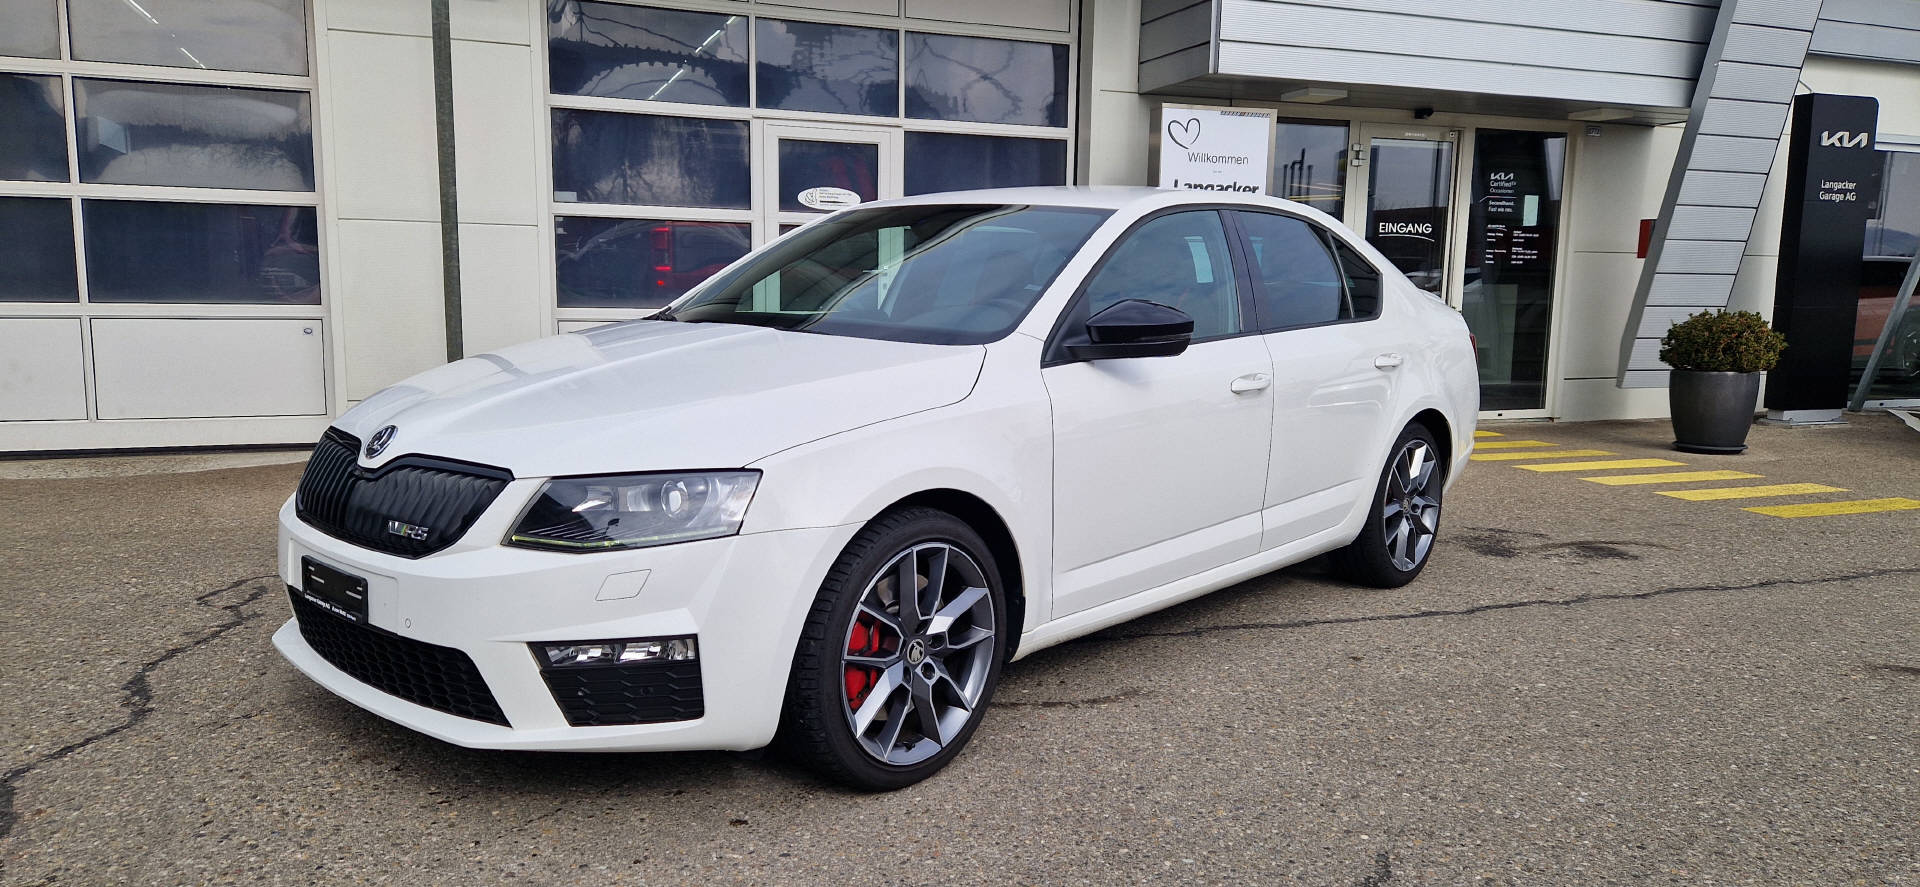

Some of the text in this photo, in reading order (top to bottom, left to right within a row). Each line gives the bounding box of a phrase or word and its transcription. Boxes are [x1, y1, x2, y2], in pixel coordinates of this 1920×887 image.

[1821, 131, 1869, 148] KIA
[1188, 152, 1249, 165] Willkommen
[1490, 172, 1514, 180] KIA
[1821, 180, 1856, 191] Langacker
[1819, 191, 1856, 203] Garage AG
[1379, 222, 1433, 234] EINGANG
